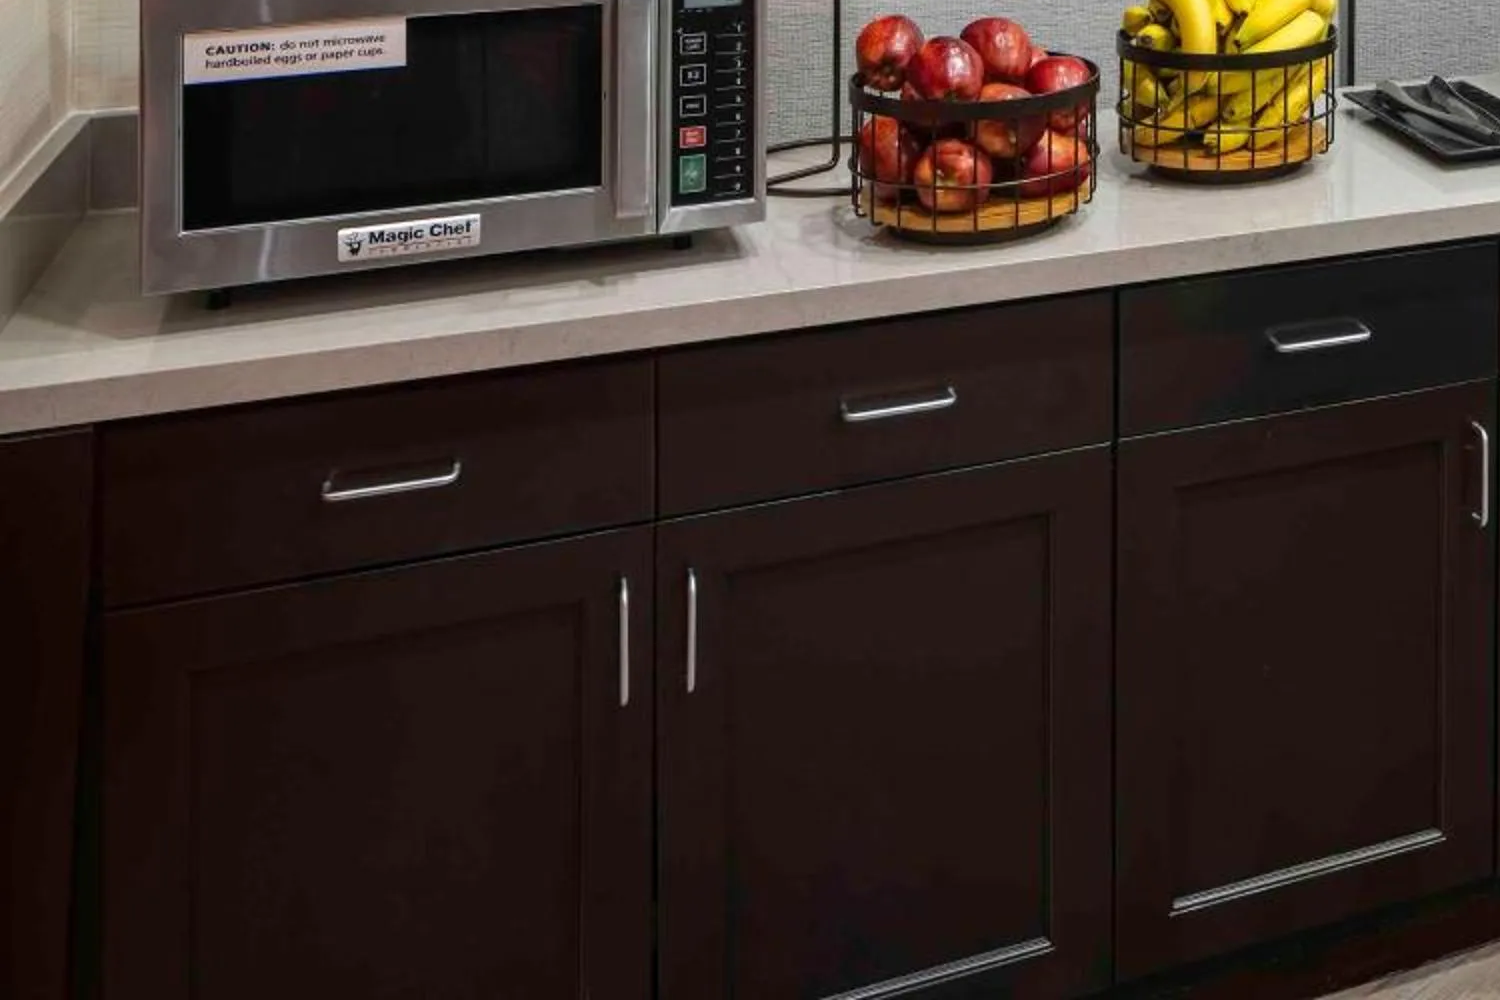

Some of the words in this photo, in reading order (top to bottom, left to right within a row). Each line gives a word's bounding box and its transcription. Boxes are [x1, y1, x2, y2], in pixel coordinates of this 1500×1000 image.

[205, 41, 275, 57] CAUTION:
[279, 39, 297, 50] do
[299, 39, 319, 49] not
[323, 34, 386, 47] microwave
[205, 55, 271, 69] hardboiled
[274, 53, 303, 64] eggs
[305, 53, 317, 61] or
[321, 49, 354, 61] paper
[368, 226, 425, 244] Magic
[429, 220, 472, 237] Chef
